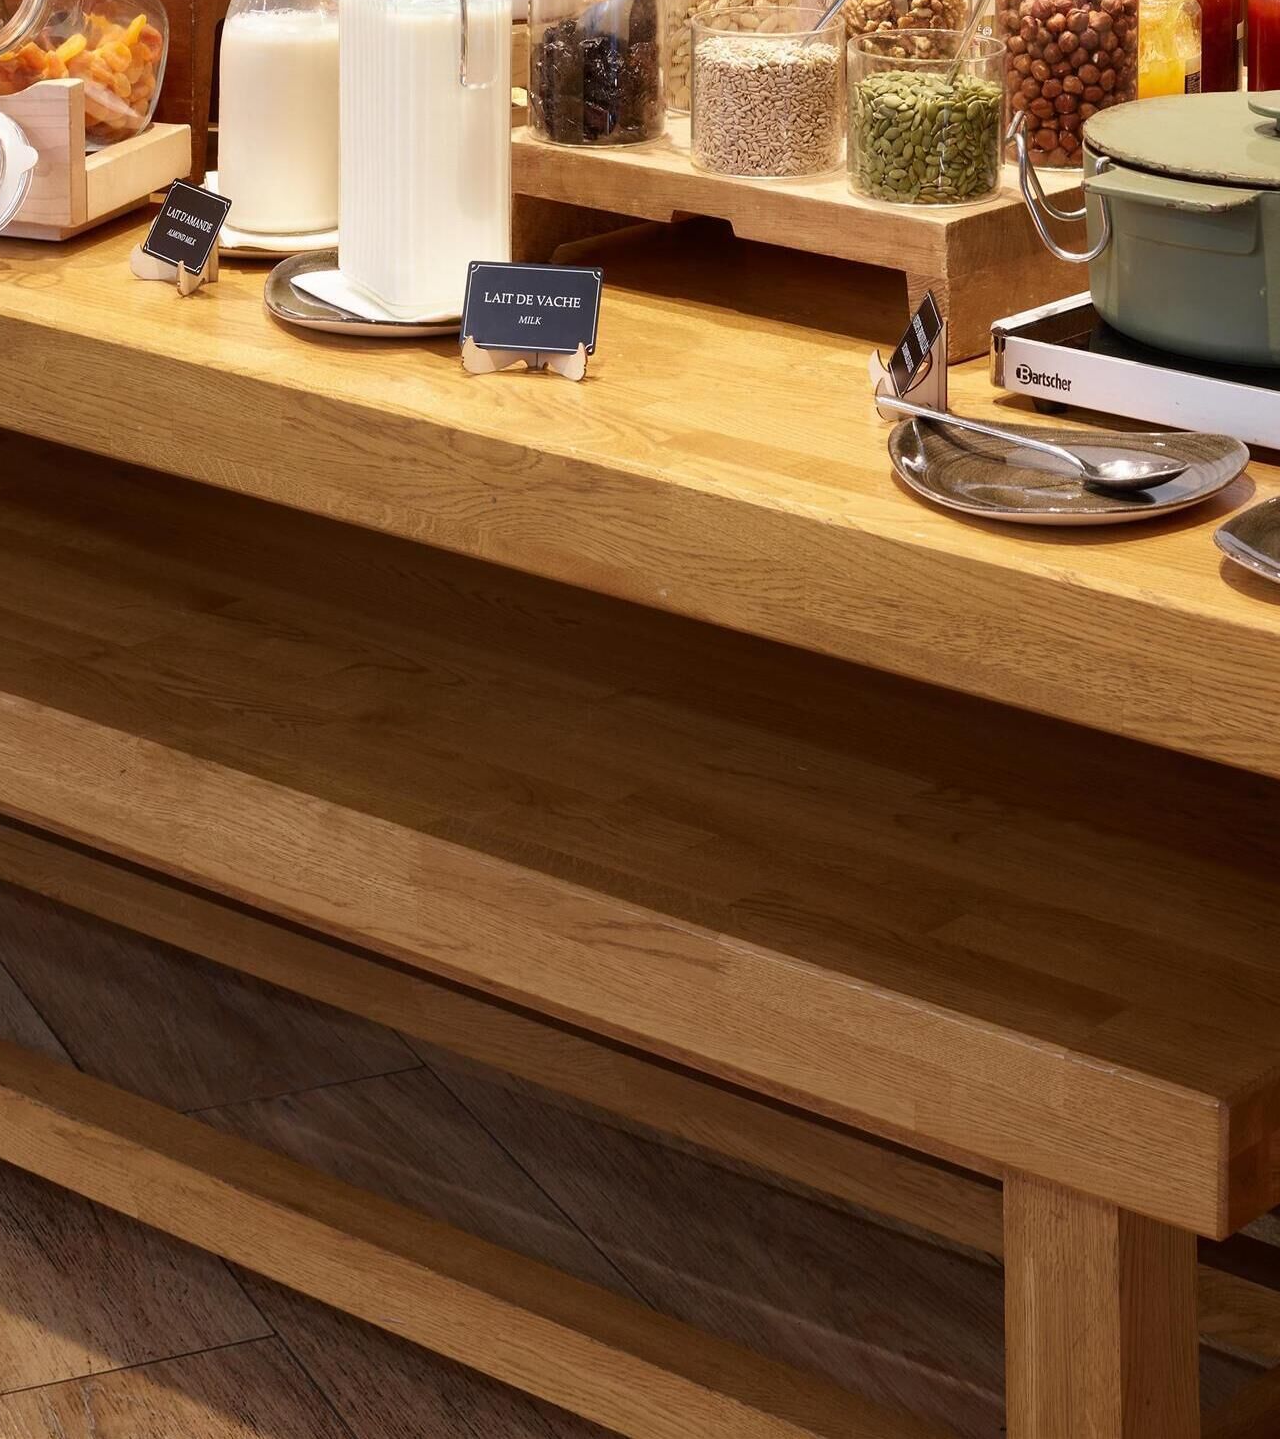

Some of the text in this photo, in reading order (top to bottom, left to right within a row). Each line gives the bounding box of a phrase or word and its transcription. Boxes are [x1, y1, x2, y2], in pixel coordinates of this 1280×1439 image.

[166, 206, 214, 233] LAIT D'AMANDE
[166, 228, 187, 242] ALMOND
[484, 292, 581, 309] LAIT DE VACHE
[518, 315, 542, 325] MILK
[1016, 363, 1072, 391] Bartscher
